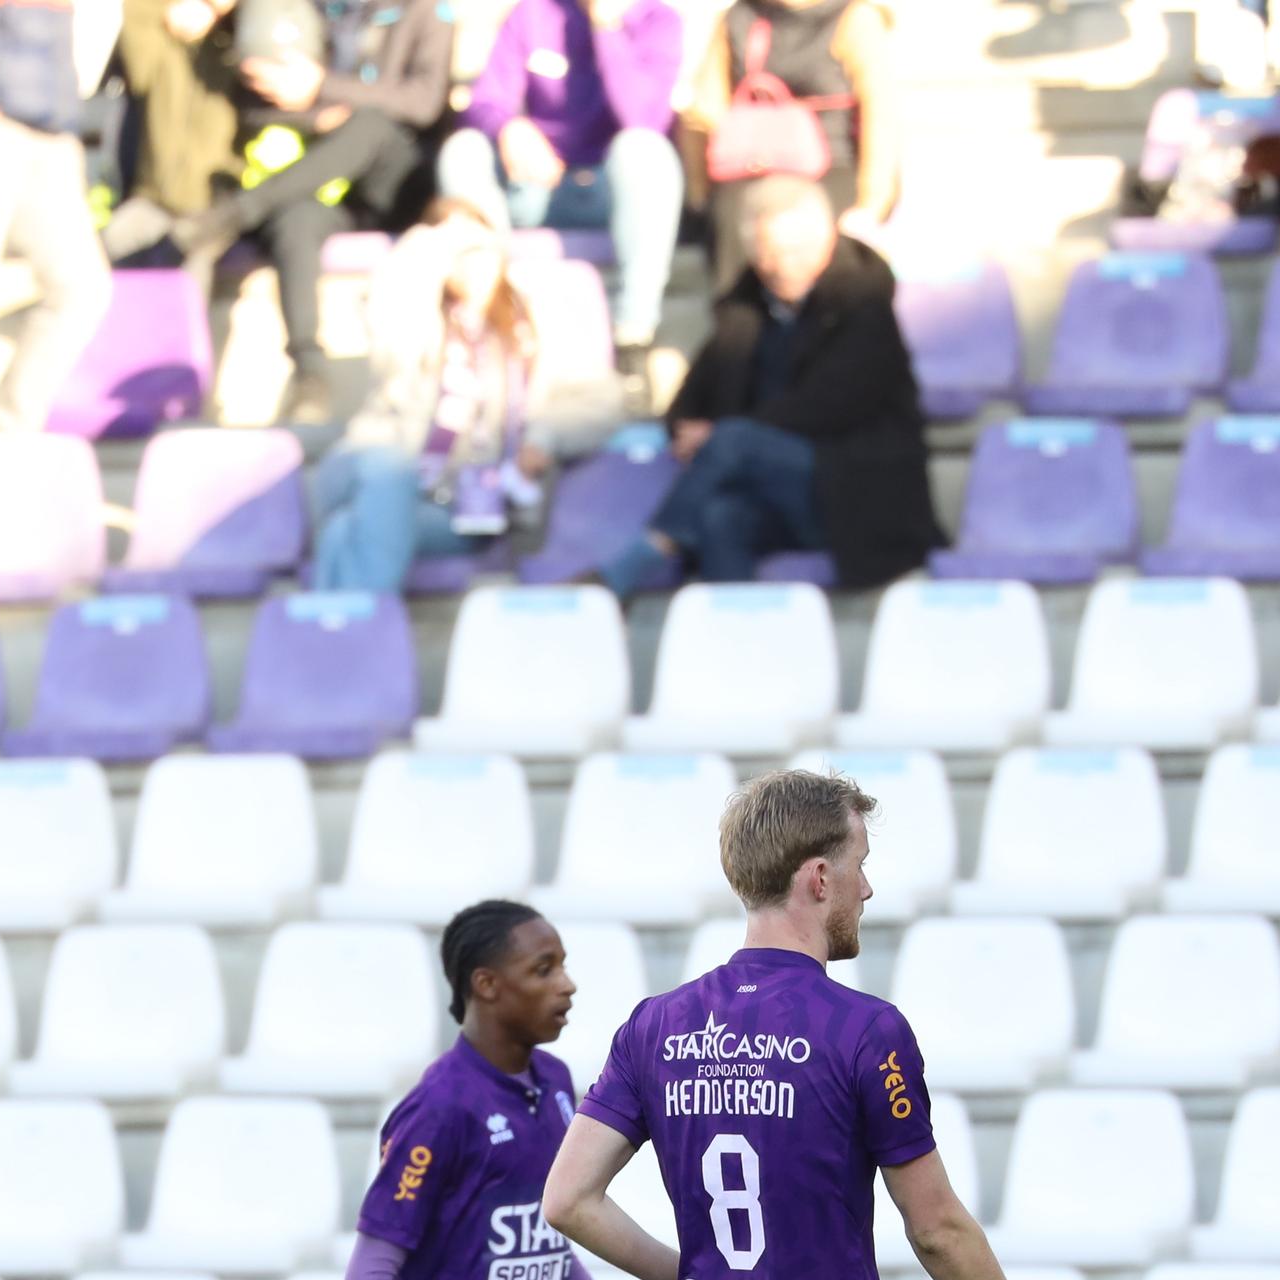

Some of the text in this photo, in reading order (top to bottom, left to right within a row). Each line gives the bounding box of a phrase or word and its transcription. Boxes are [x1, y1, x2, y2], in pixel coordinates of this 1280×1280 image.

[665, 1079, 795, 1119] HENDERSON
[697, 1064, 765, 1078] FOUNDATION
[879, 1050, 912, 1119] YELO
[394, 1145, 433, 1201] YELO
[701, 1133, 766, 1271] 8
